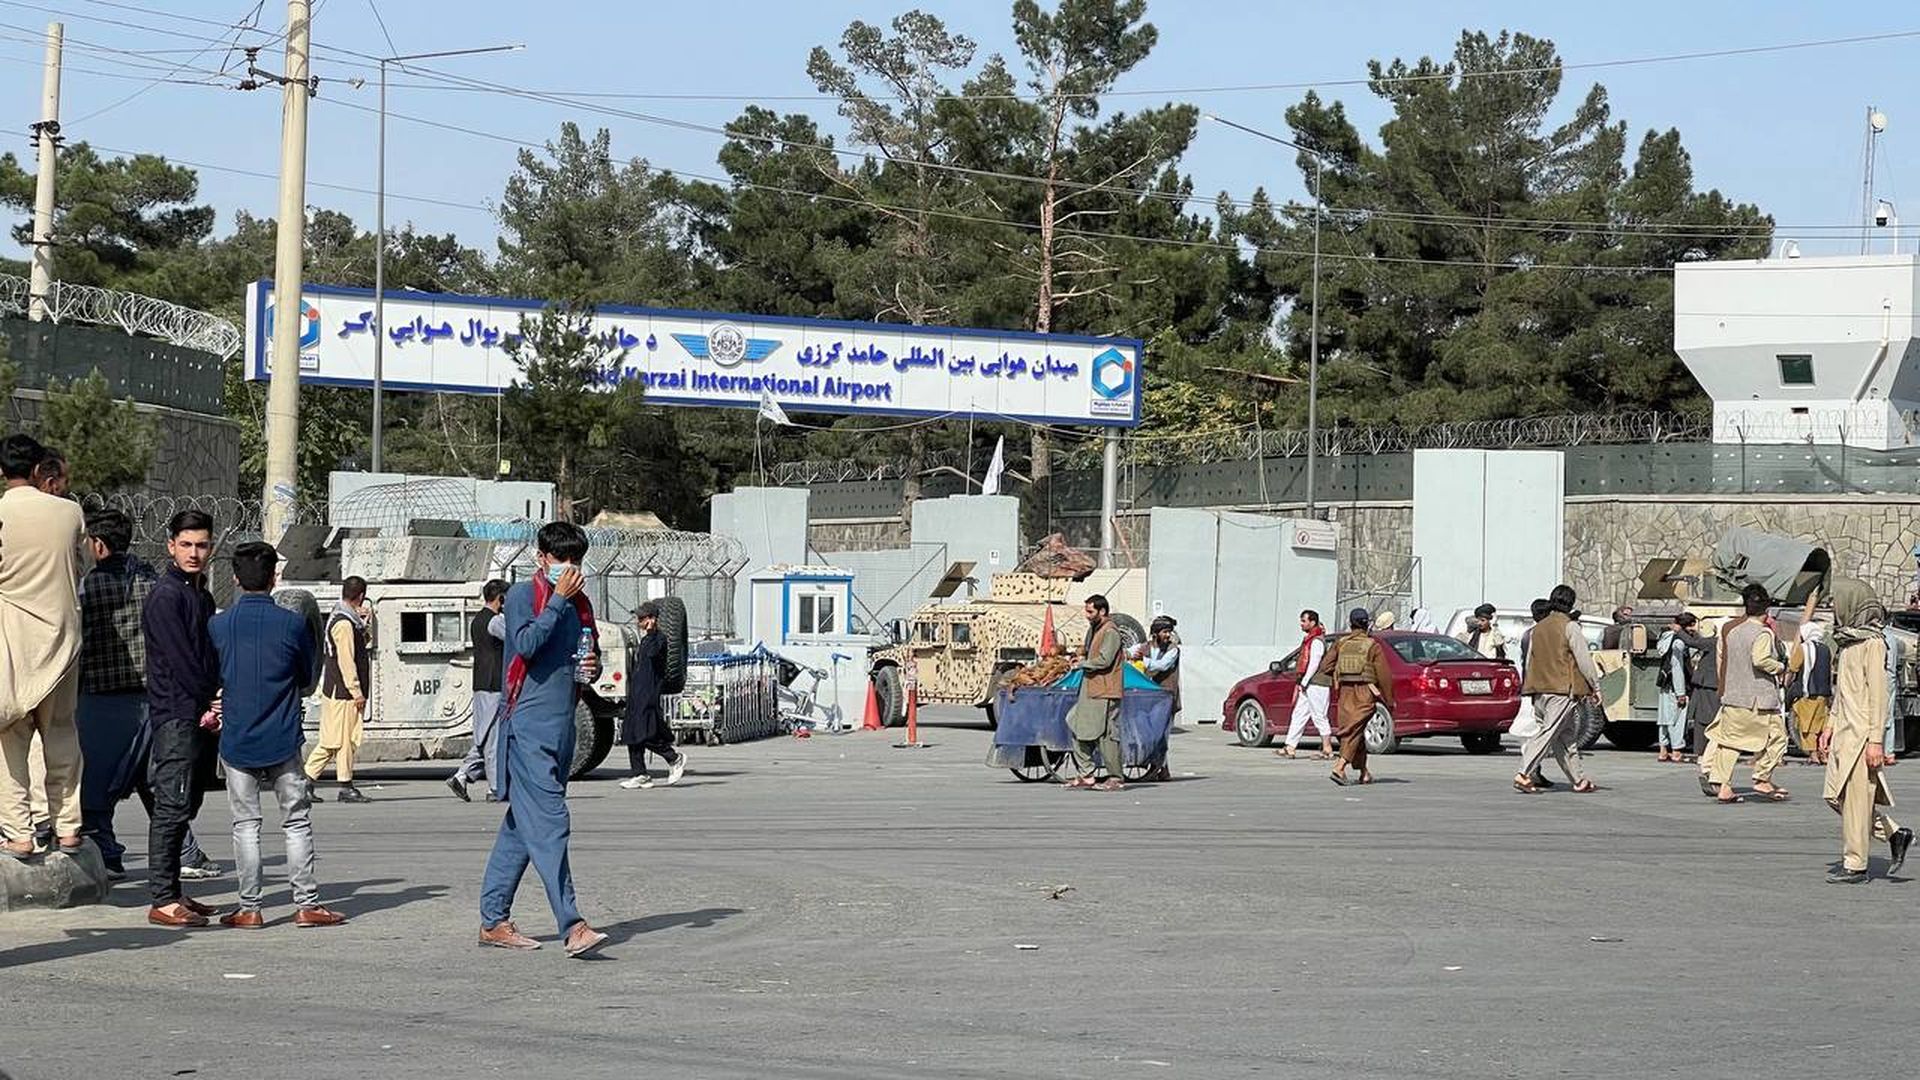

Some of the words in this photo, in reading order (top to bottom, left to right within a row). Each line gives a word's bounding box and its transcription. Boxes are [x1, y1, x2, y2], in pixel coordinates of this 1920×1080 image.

[847, 343, 888, 364] حامد
[692, 369, 818, 396] International
[823, 375, 892, 402] Airport
[412, 679, 441, 695] ABP
